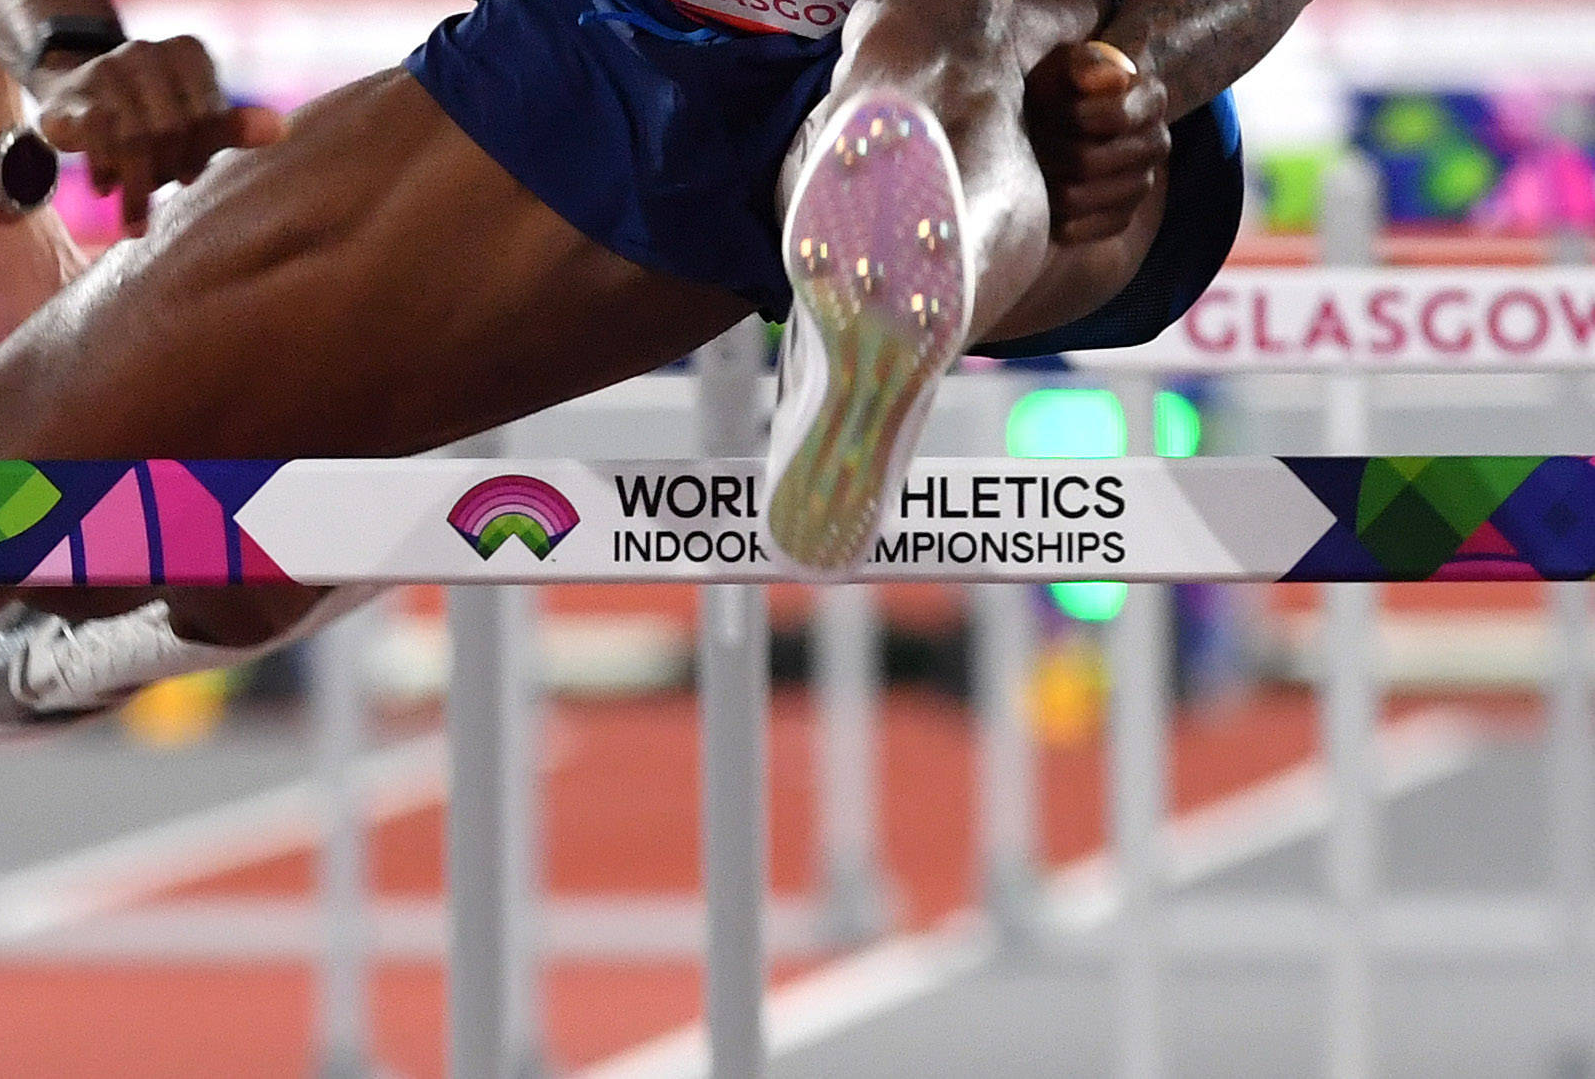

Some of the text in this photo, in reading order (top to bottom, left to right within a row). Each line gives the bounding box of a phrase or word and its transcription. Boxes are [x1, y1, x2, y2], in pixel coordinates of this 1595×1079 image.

[615, 475, 1126, 519] WORL HLETICS
[867, 530, 1126, 564] MPIONSHIPS
